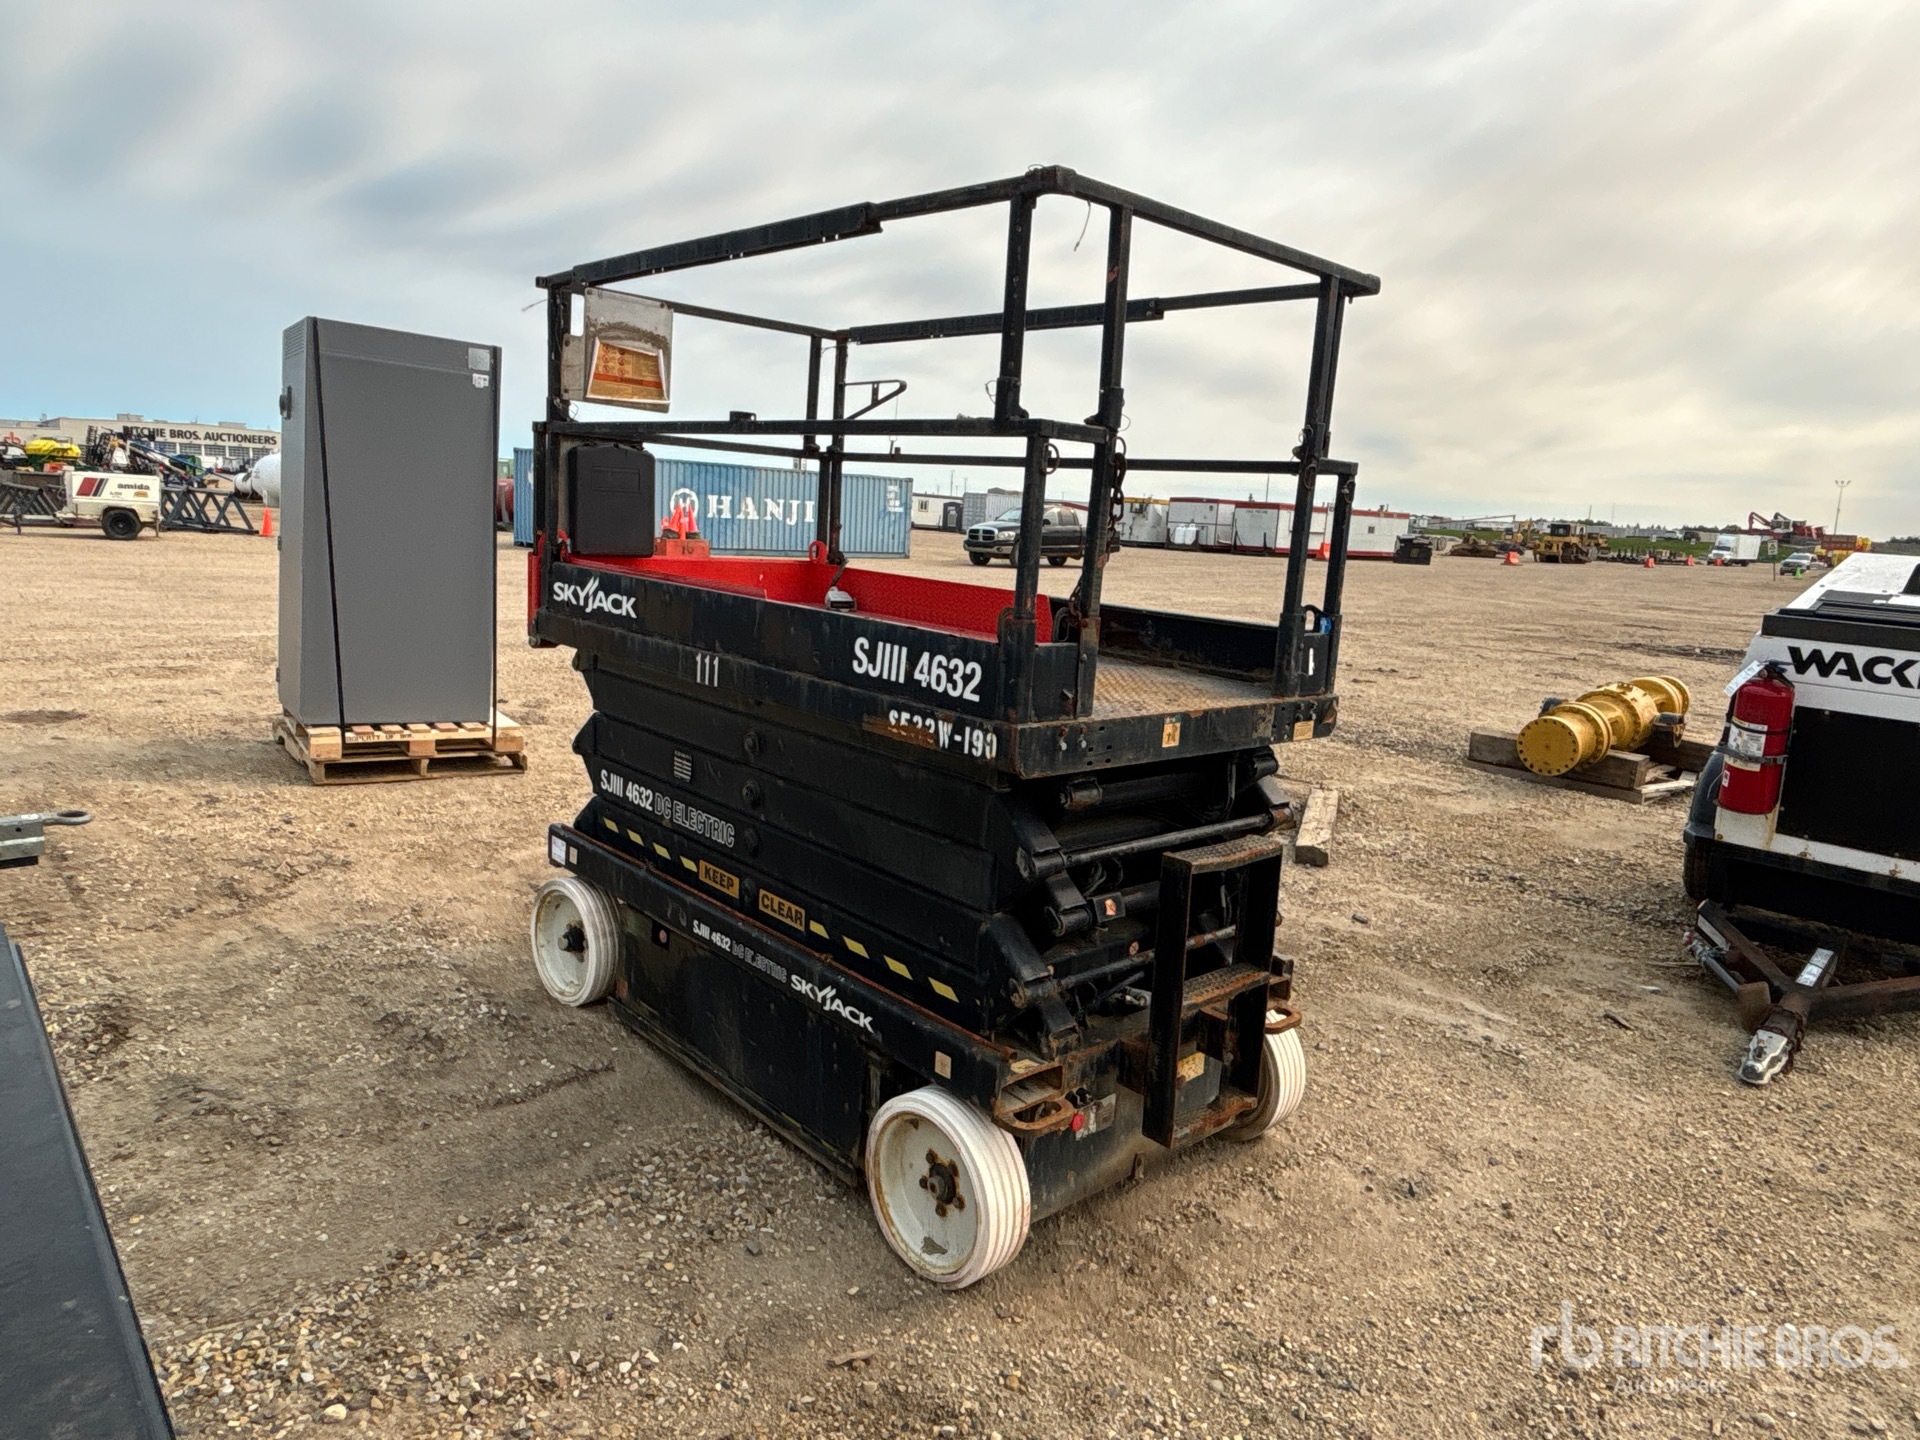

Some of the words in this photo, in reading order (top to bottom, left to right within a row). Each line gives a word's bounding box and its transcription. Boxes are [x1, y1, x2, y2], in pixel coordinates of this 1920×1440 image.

[169, 429, 201, 441] BROS.
[203, 431, 278, 446] AUCTIONEERS
[117, 483, 150, 491] amida
[706, 494, 816, 526] HANJI
[552, 576, 638, 619] SKYJACK
[852, 636, 908, 684] SJIII
[913, 651, 983, 703] 4632
[1787, 645, 1920, 690] WACK
[600, 768, 624, 798] SJIII
[625, 781, 653, 812] 4632
[654, 792, 672, 820] DC
[673, 799, 735, 848] ELECTRIC
[703, 864, 734, 891] KEEP
[760, 893, 804, 928] CLEAR
[711, 931, 731, 952] 4632
[790, 973, 875, 1034] SKYJACK
